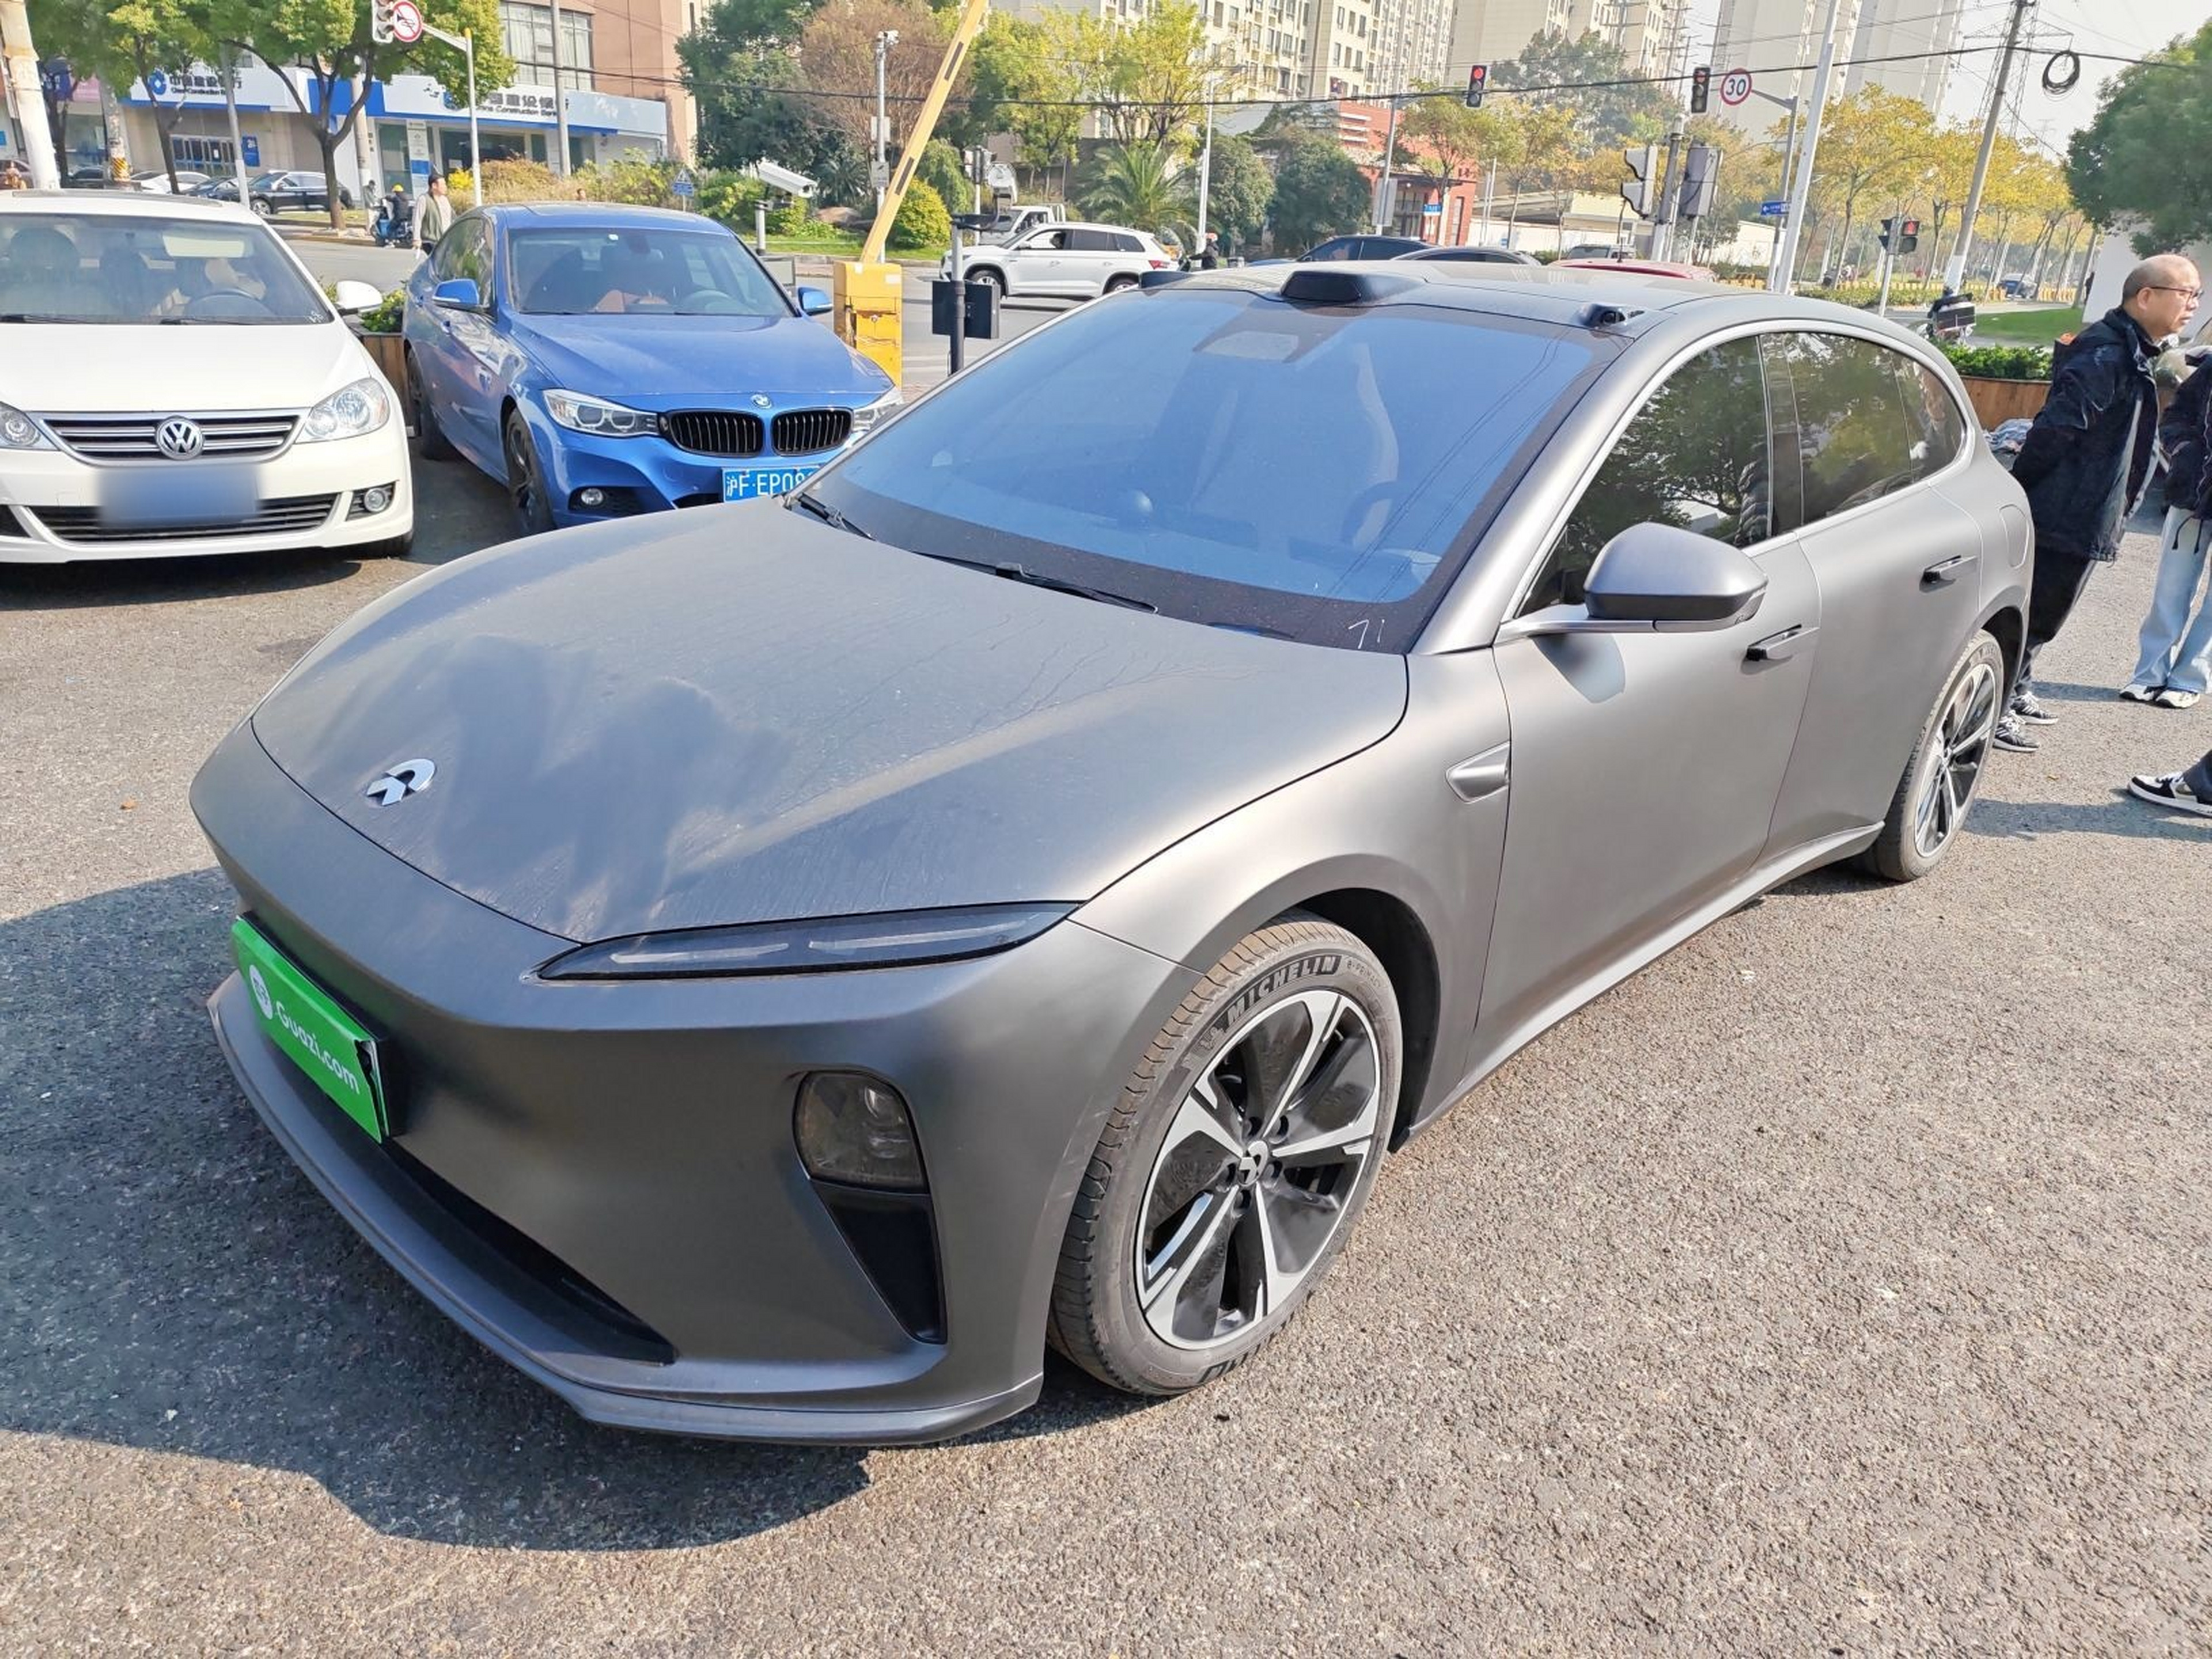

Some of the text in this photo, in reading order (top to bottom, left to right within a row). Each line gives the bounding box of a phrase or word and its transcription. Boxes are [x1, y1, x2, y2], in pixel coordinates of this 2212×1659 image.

[1726, 78, 1746, 96] 30
[1226, 956, 1336, 1024] MICHELIN
[276, 1001, 360, 1095] Guazi.com
